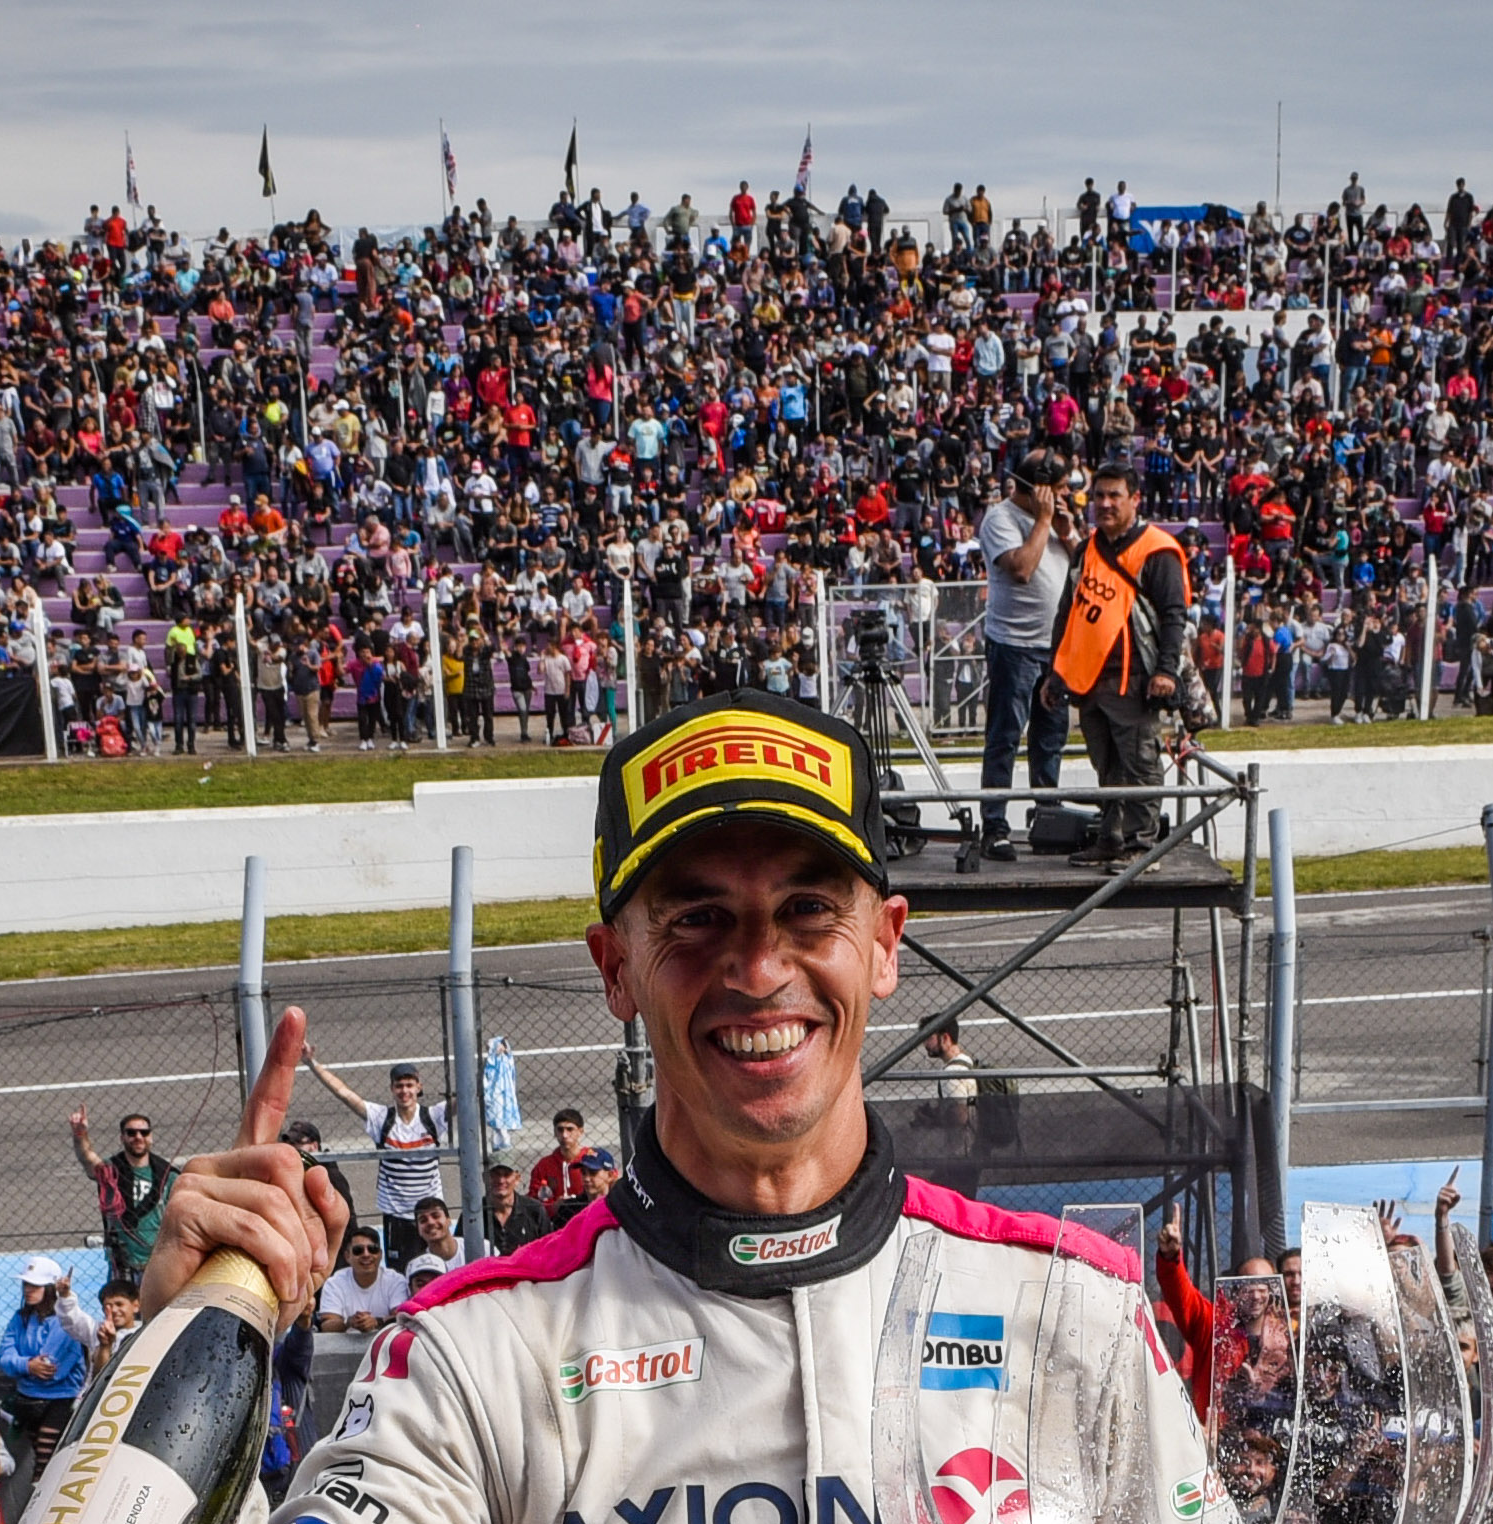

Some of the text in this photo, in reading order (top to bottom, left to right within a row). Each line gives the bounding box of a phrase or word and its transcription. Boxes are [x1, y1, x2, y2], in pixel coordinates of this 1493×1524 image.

[641, 726, 832, 805] PIRELLI
[758, 1223, 834, 1262] Castrol
[583, 1343, 694, 1390] Castrol
